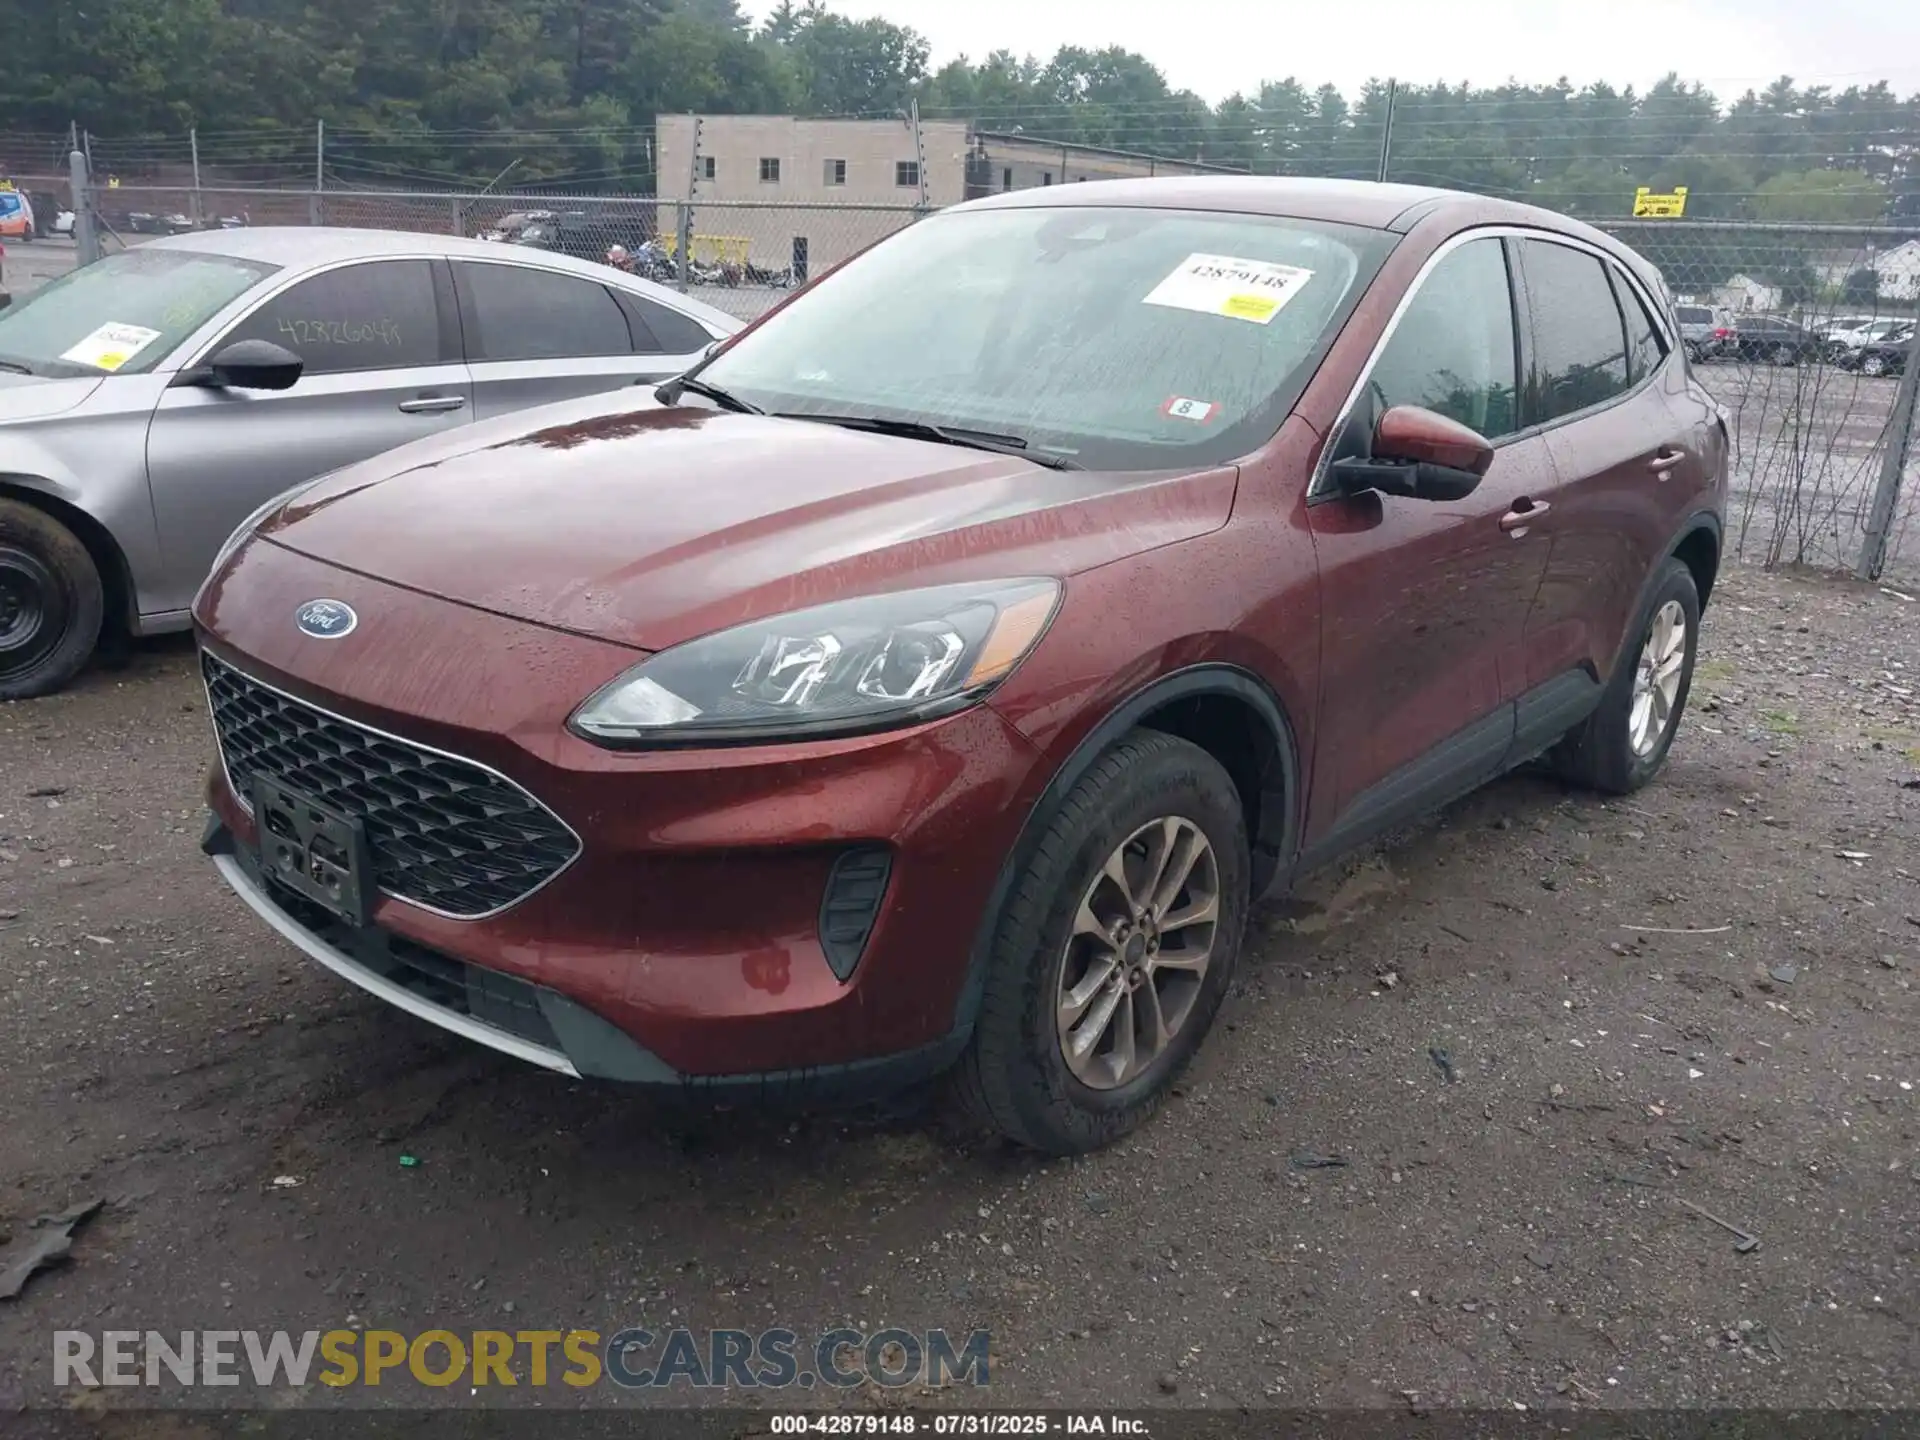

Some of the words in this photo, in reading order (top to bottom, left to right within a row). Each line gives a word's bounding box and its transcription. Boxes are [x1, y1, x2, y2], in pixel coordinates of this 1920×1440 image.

[1189, 265, 1288, 289] 42879148
[1178, 401, 1193, 414] 8
[302, 604, 340, 629] Ford
